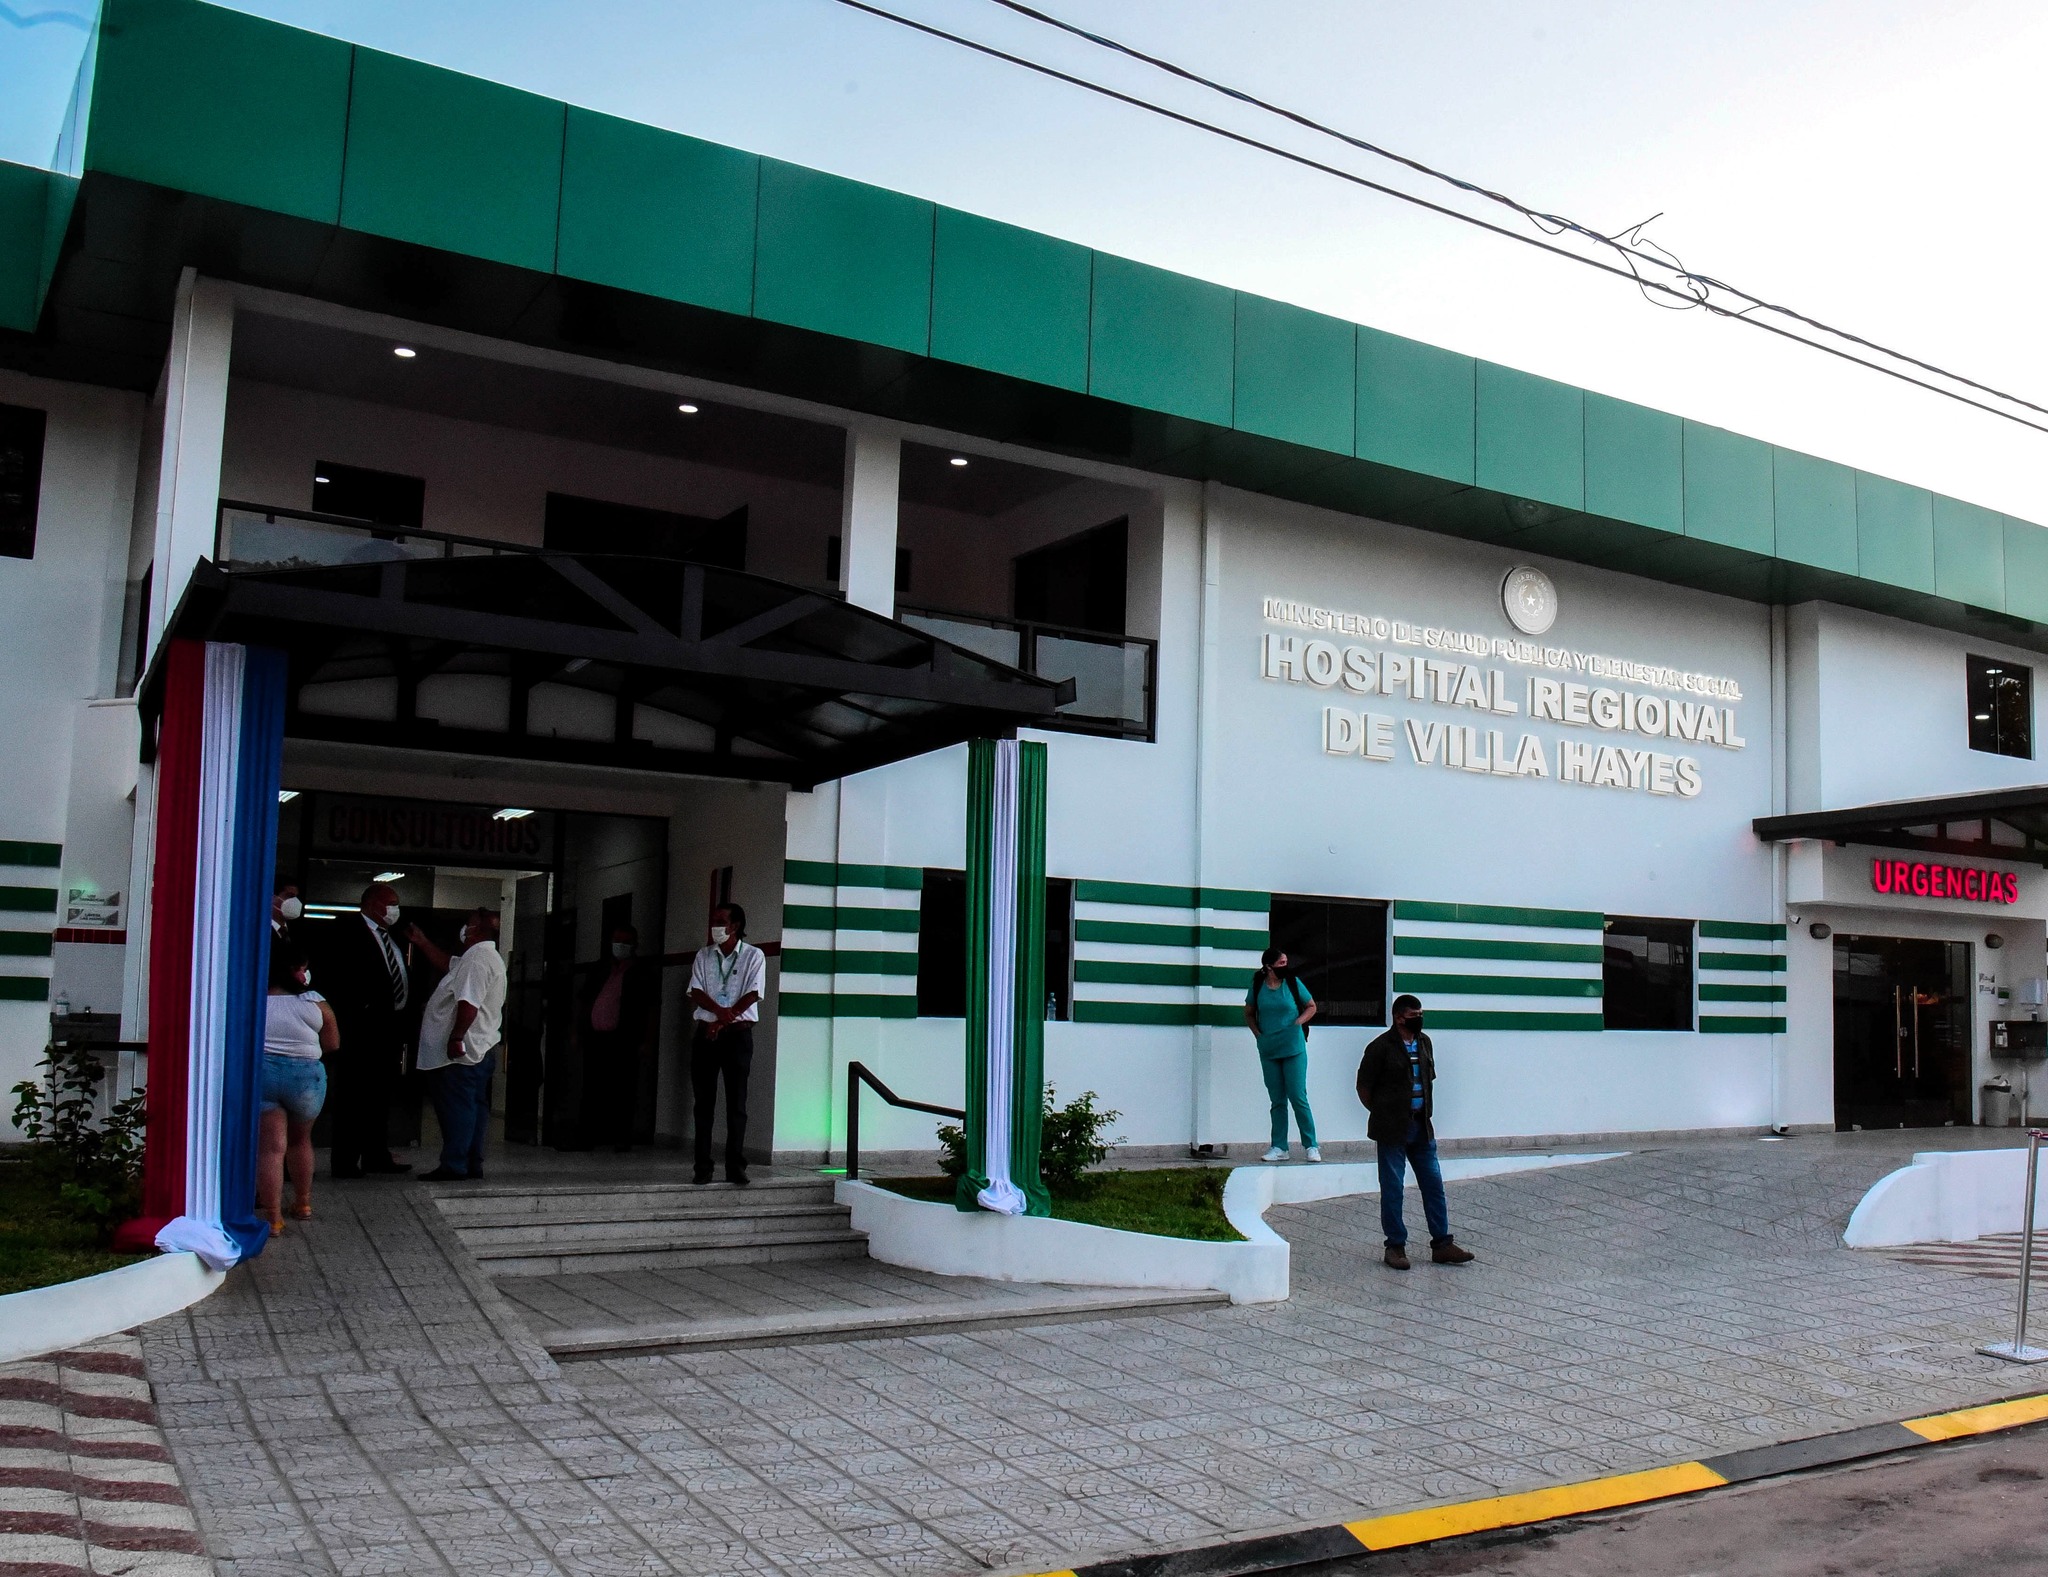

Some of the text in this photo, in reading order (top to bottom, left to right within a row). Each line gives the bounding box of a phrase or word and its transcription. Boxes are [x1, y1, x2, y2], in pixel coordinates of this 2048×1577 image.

[1261, 633, 1746, 750] HOSPITAL REGIONAL
[1263, 599, 1743, 699] MINISTERIO DE SALUD PÚBLICA Y BIENESTAR SOCIAL
[1322, 706, 1703, 799] DE VILLA HAYES
[329, 805, 540, 855] CONSULTORIOS
[1873, 858, 2019, 905] URGENCIAS
